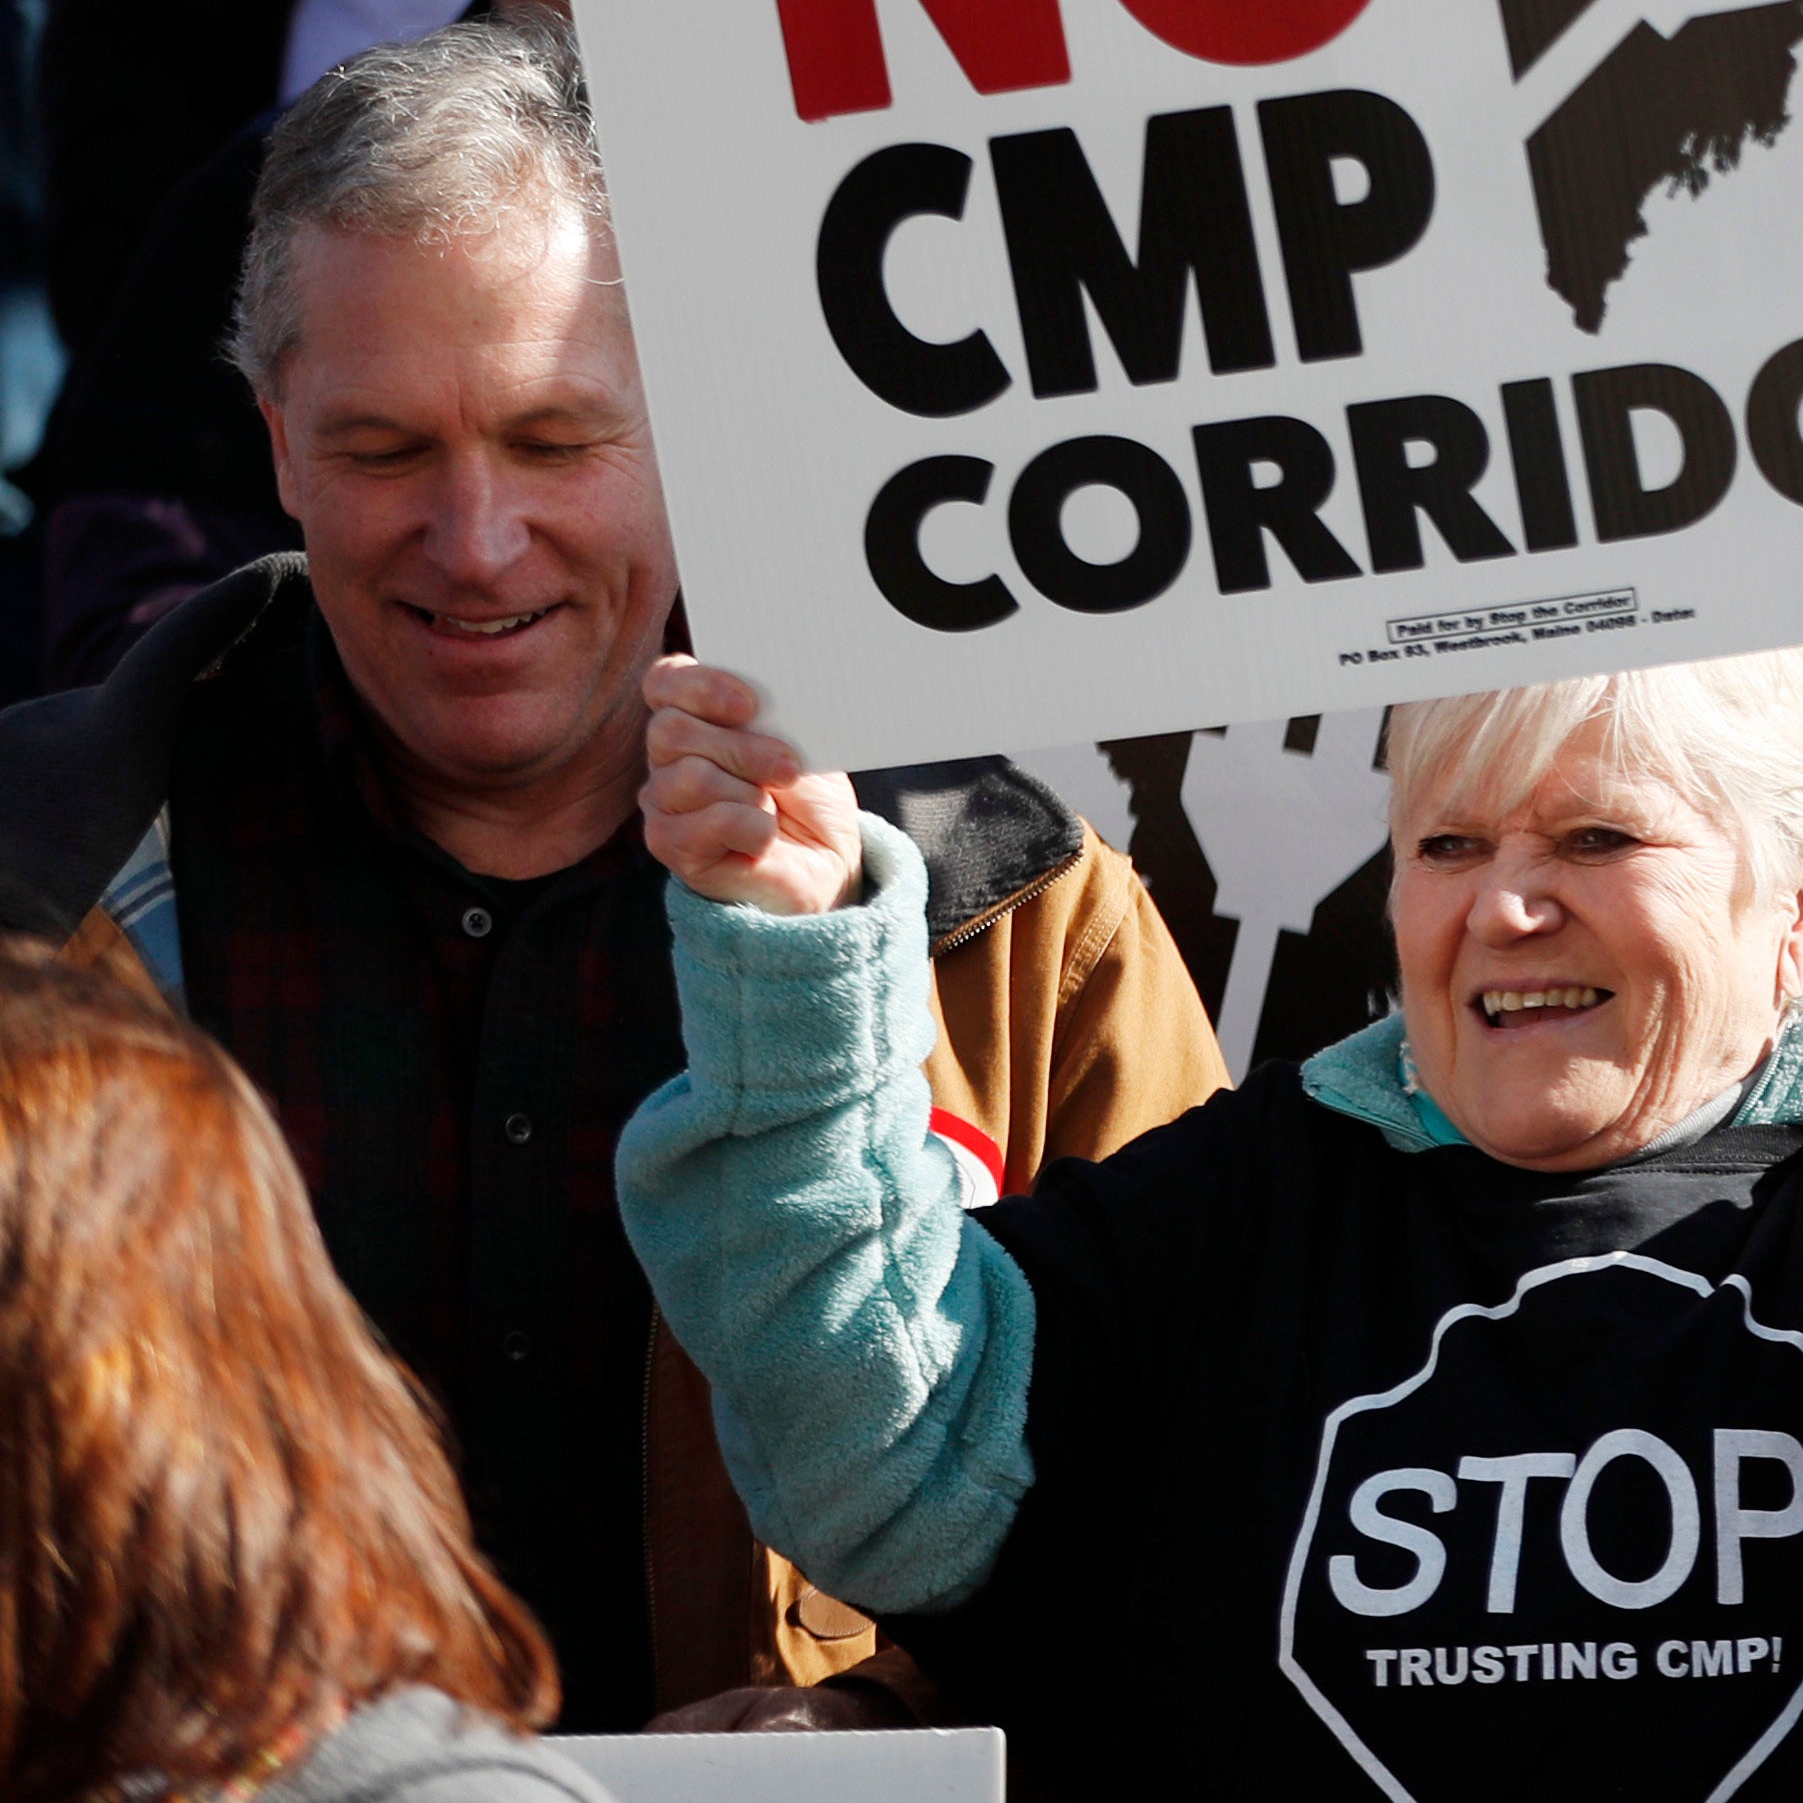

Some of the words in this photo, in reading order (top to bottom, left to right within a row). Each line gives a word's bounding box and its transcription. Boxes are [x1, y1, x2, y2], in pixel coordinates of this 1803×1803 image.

[816, 88, 1435, 418] CMP
[1396, 621, 1433, 638] Paid
[1437, 618, 1460, 632] for
[1464, 616, 1483, 630] by
[1489, 611, 1526, 625] Stop
[1532, 606, 1558, 619] the
[1564, 596, 1630, 614] Corridor
[1339, 652, 1363, 666] PO
[1368, 649, 1399, 663] Box
[1532, 625, 1580, 640] Maine
[1366, 1642, 1638, 1687] TRUSTING
[1656, 1636, 1782, 1678] CMP!
